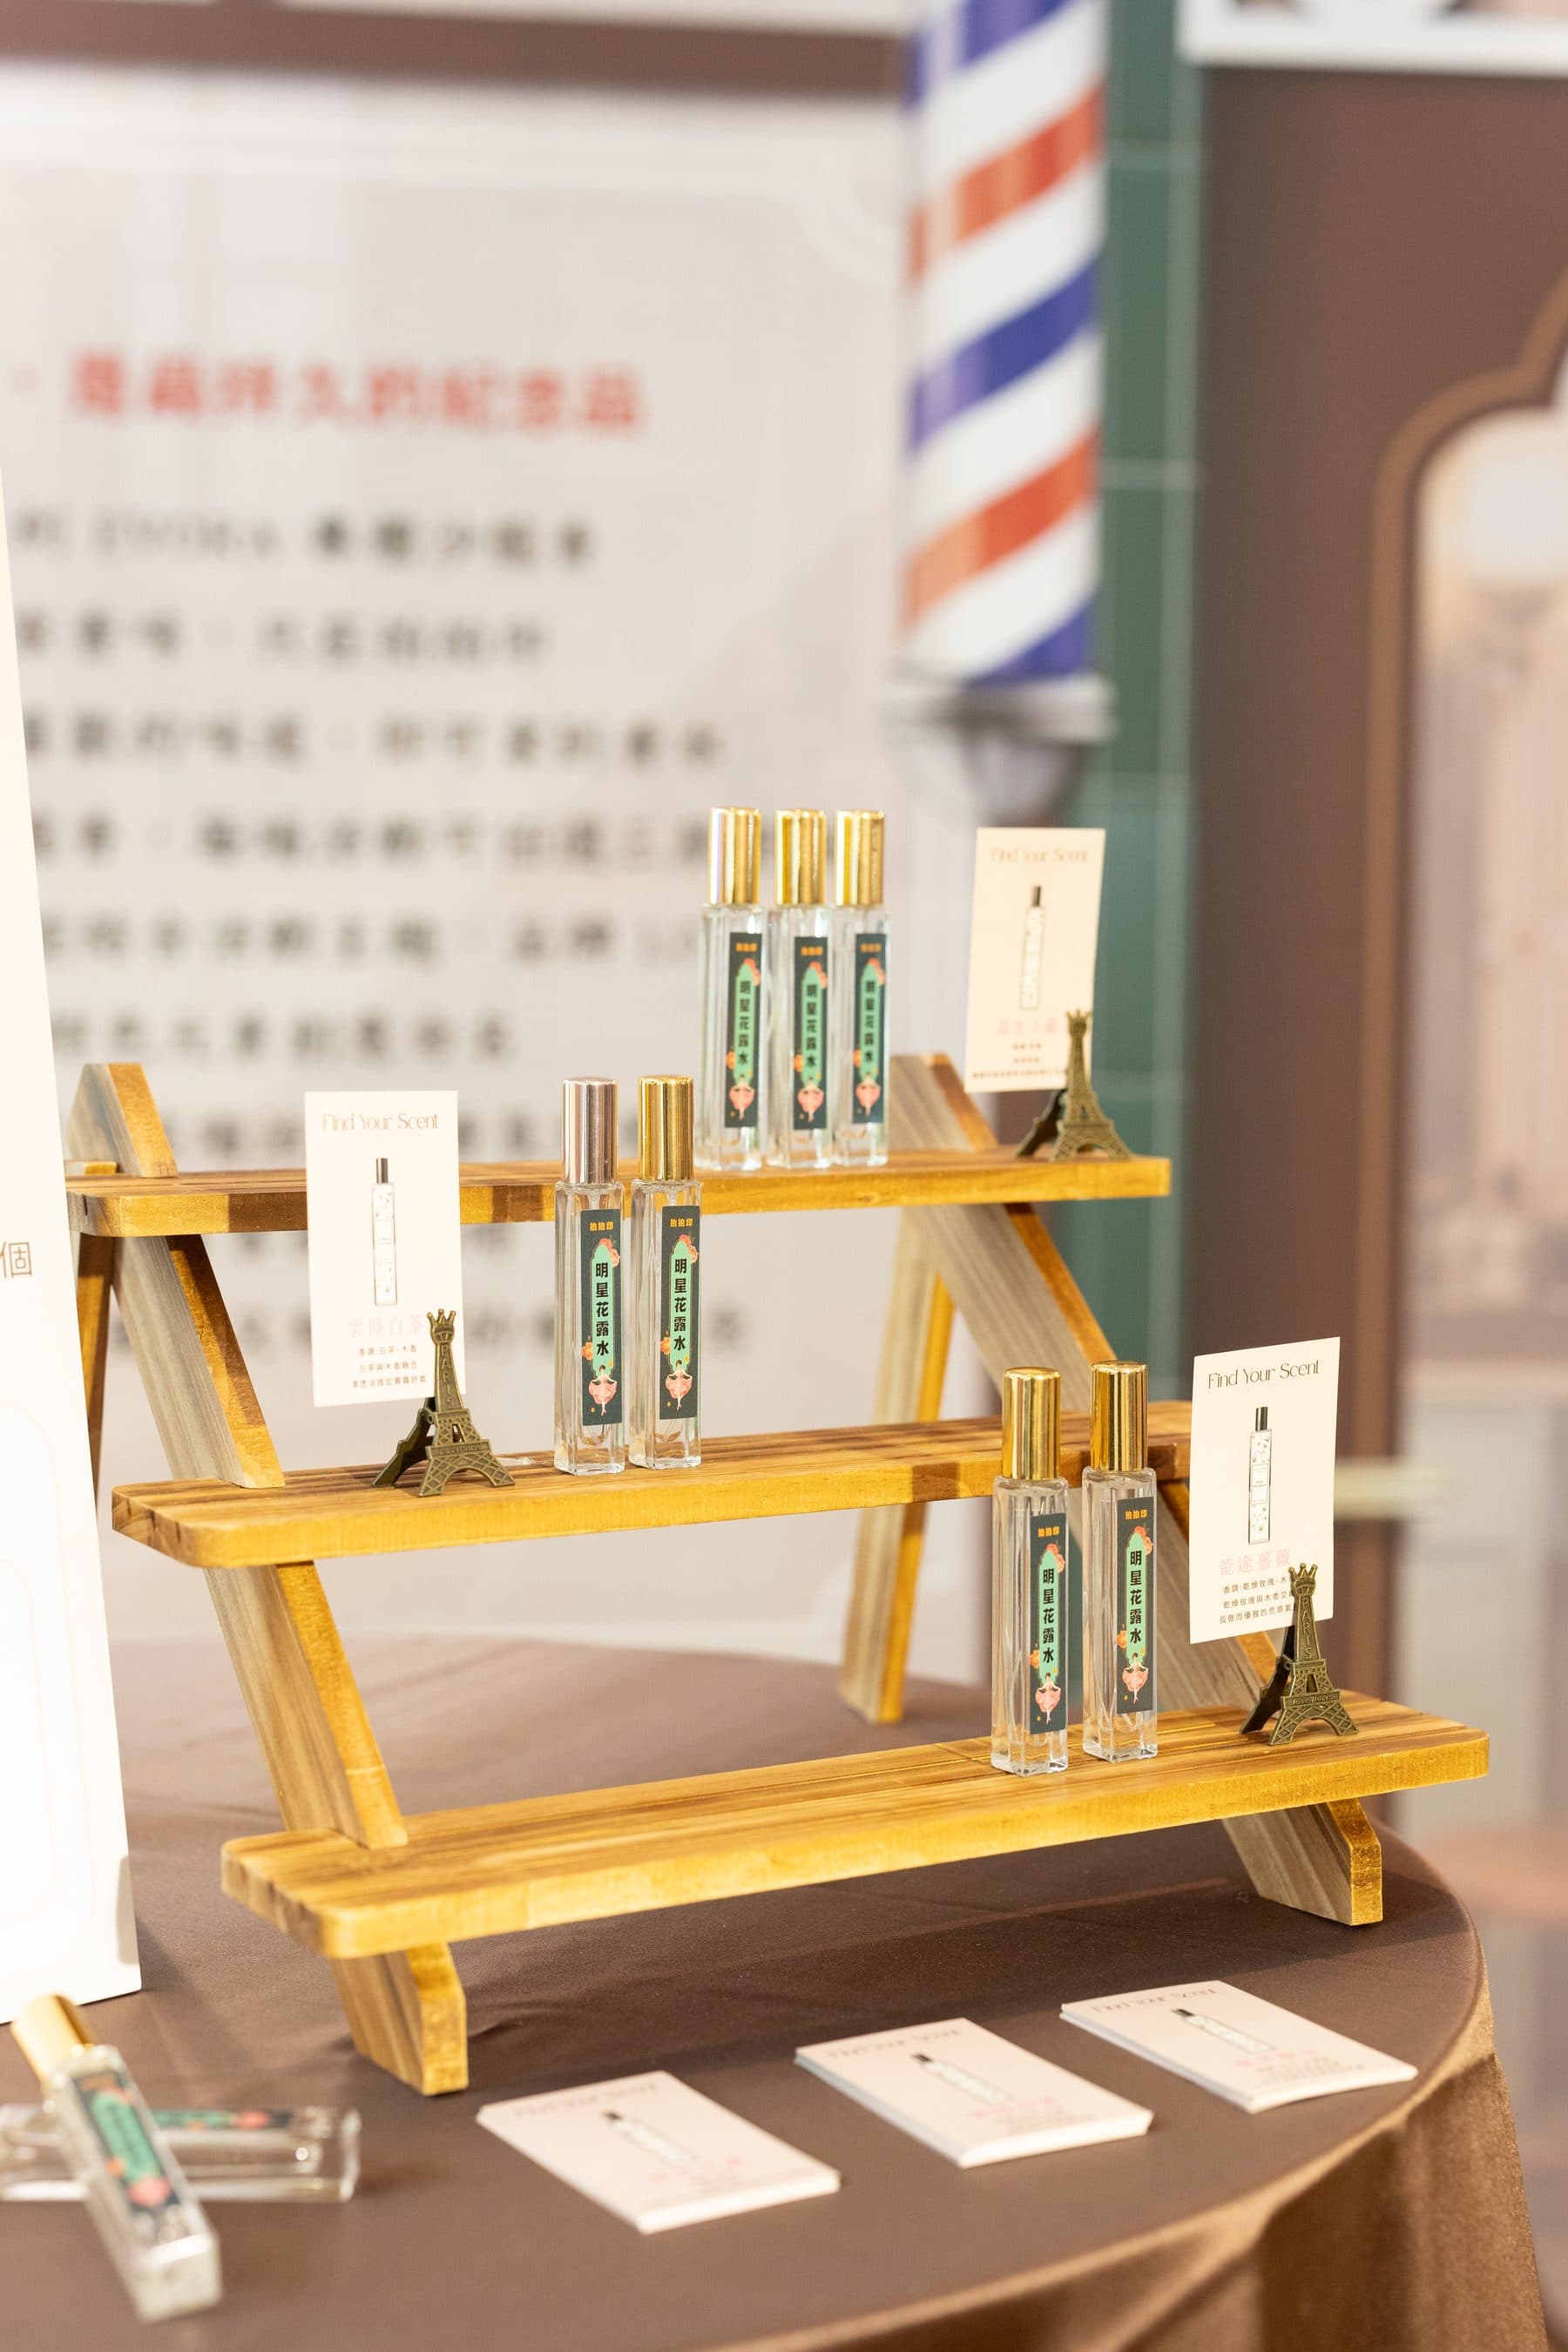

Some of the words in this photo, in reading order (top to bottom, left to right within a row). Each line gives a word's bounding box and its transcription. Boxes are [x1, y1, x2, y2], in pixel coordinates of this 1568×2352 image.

[323, 1114, 355, 1130] Find
[358, 1114, 394, 1130] Your
[398, 1113, 437, 1130] Scent
[595, 1262, 610, 1356] 明星花露水
[673, 1259, 687, 1352] 明星花露水
[440, 1344, 454, 1409] PARIS
[1207, 1369, 1238, 1389] Find
[1243, 1369, 1275, 1384] Your
[1280, 1360, 1319, 1379] Scent
[1043, 1568, 1055, 1664] 明星花露水
[1130, 1550, 1142, 1644] 明星花露水
[1223, 1591, 1293, 1609] 乾燥玫瑰與木香交
[1301, 1597, 1312, 1659] PARIS
